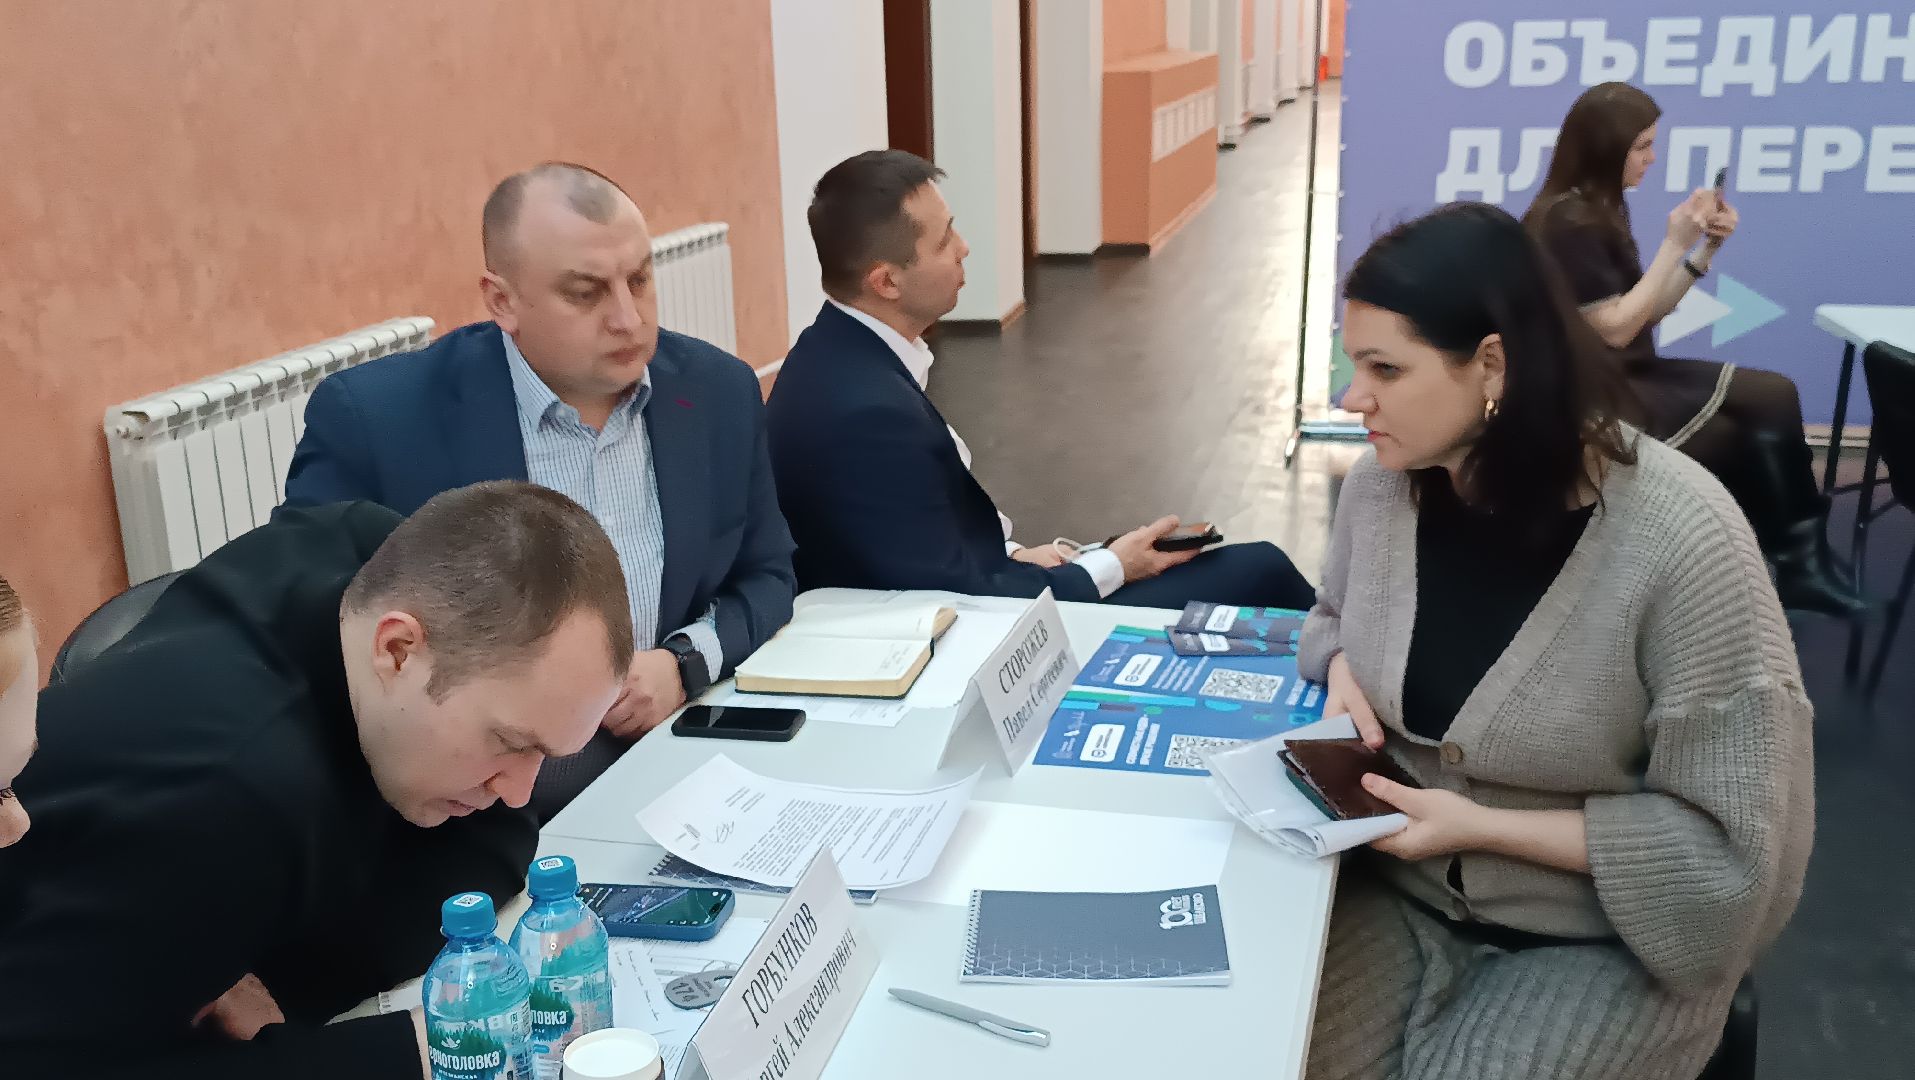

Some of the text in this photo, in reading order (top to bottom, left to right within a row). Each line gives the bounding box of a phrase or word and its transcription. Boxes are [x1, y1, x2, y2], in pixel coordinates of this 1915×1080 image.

[1443, 13, 1915, 97] ОБЪЕДИН
[1435, 126, 1915, 204] ДЛ ПЕРЕ
[998, 618, 1049, 694] СТОРОЖЕВ
[1002, 699, 1035, 744] Павел
[741, 902, 818, 1029] ГОРБУНКОВ
[783, 927, 857, 1057] Александрович
